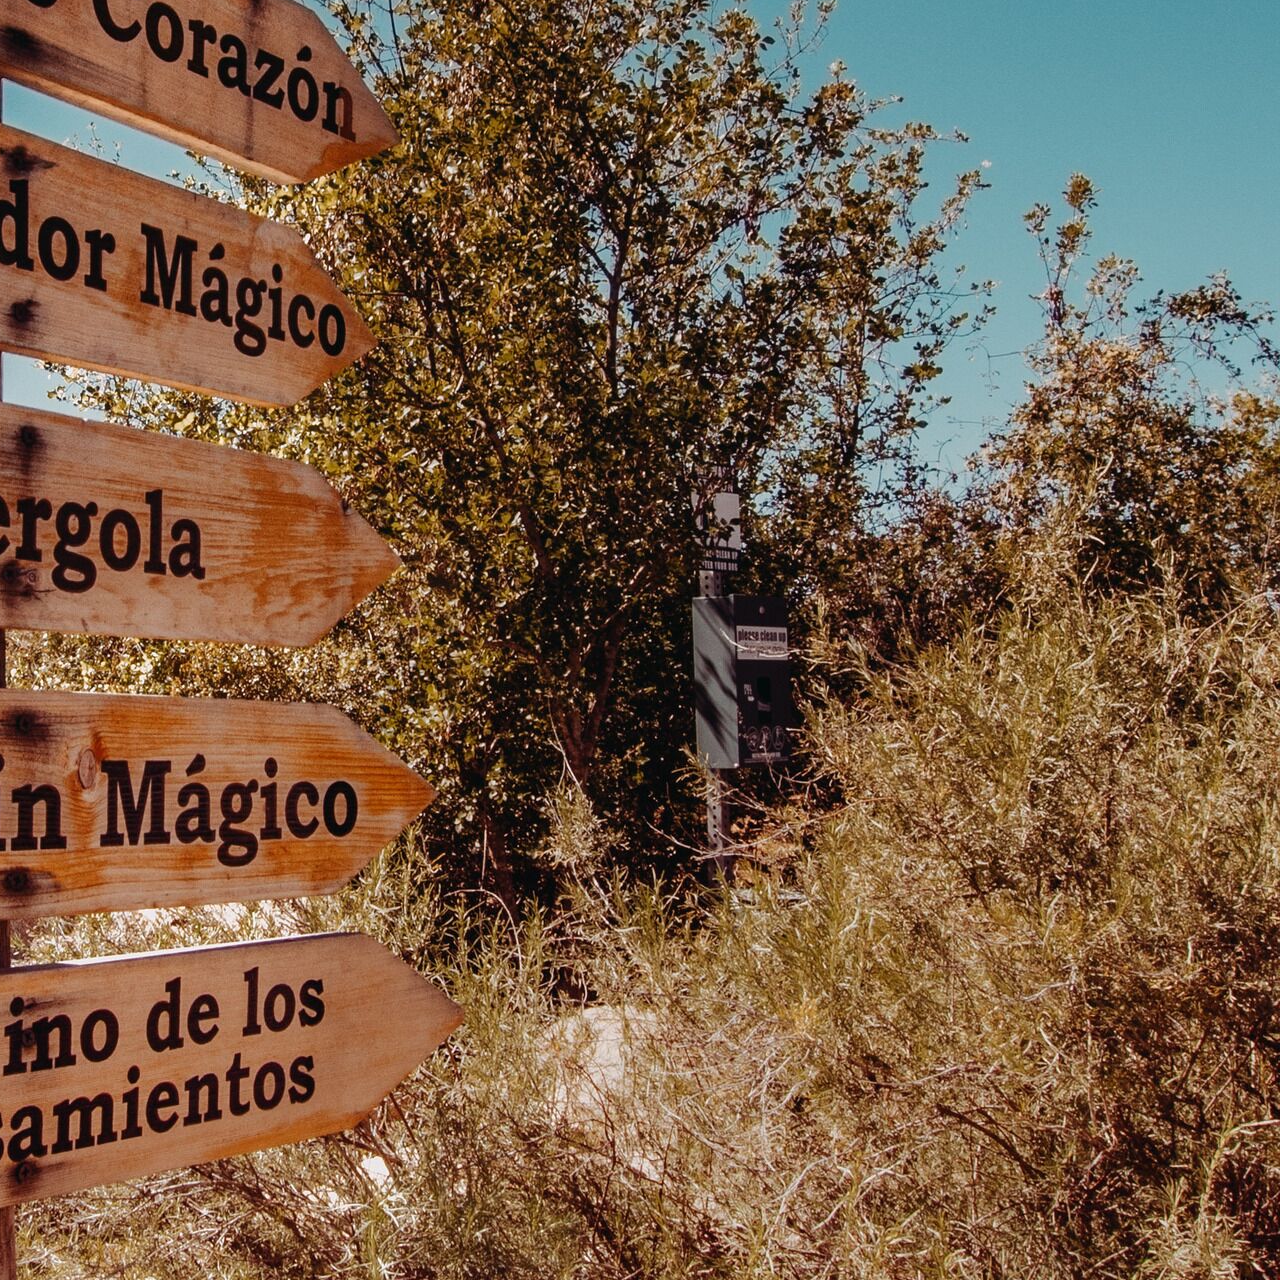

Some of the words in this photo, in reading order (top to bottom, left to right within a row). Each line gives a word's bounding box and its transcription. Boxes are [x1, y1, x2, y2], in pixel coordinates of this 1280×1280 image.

[140, 223, 347, 357] Mágico
[760, 629, 777, 641] clean
[100, 754, 358, 868] Mágico
[147, 977, 219, 1052] de
[243, 967, 324, 1036] los
